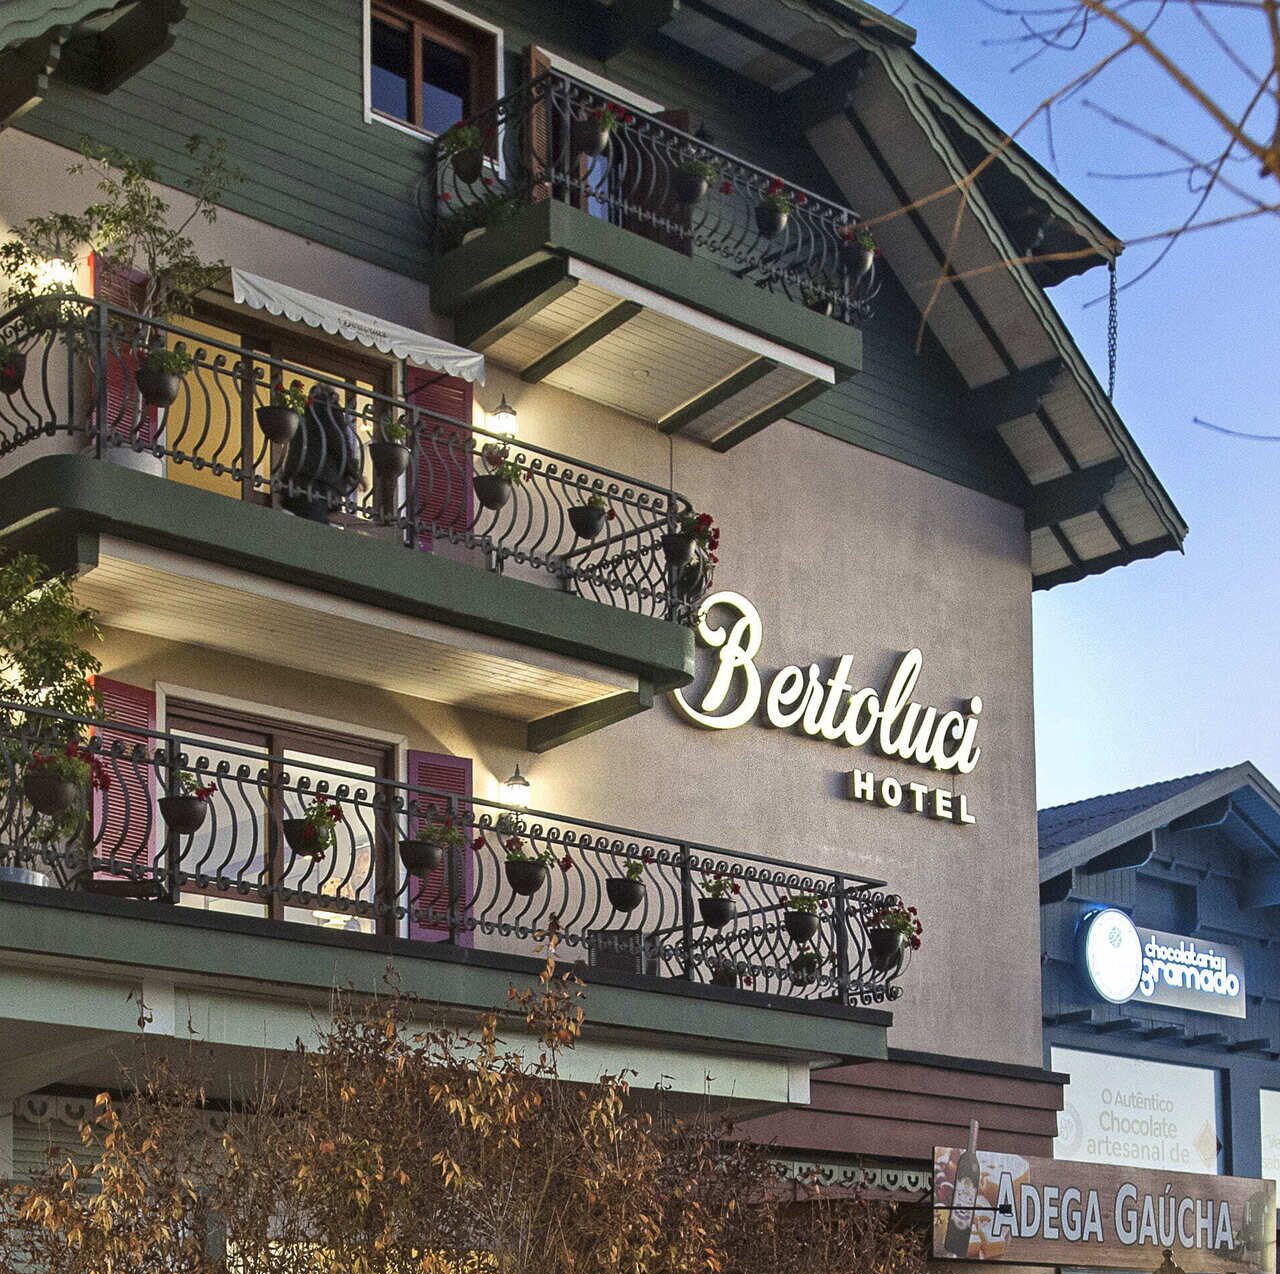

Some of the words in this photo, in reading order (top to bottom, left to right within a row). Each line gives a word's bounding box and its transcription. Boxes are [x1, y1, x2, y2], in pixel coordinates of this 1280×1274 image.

[673, 590, 982, 774] Bertoluci
[851, 769, 976, 825] HOTEL
[1144, 935, 1222, 971] chocolataria
[1139, 956, 1240, 996] gramado
[1101, 1087, 1113, 1105] O
[1115, 1090, 1174, 1113] Autêntico
[1099, 1110, 1178, 1139] Chocolate
[1087, 1135, 1165, 1162] artesanal
[1170, 1144, 1190, 1164] de
[991, 1171, 1104, 1243] ADEGA
[1115, 1183, 1235, 1250] GAÚCHA
